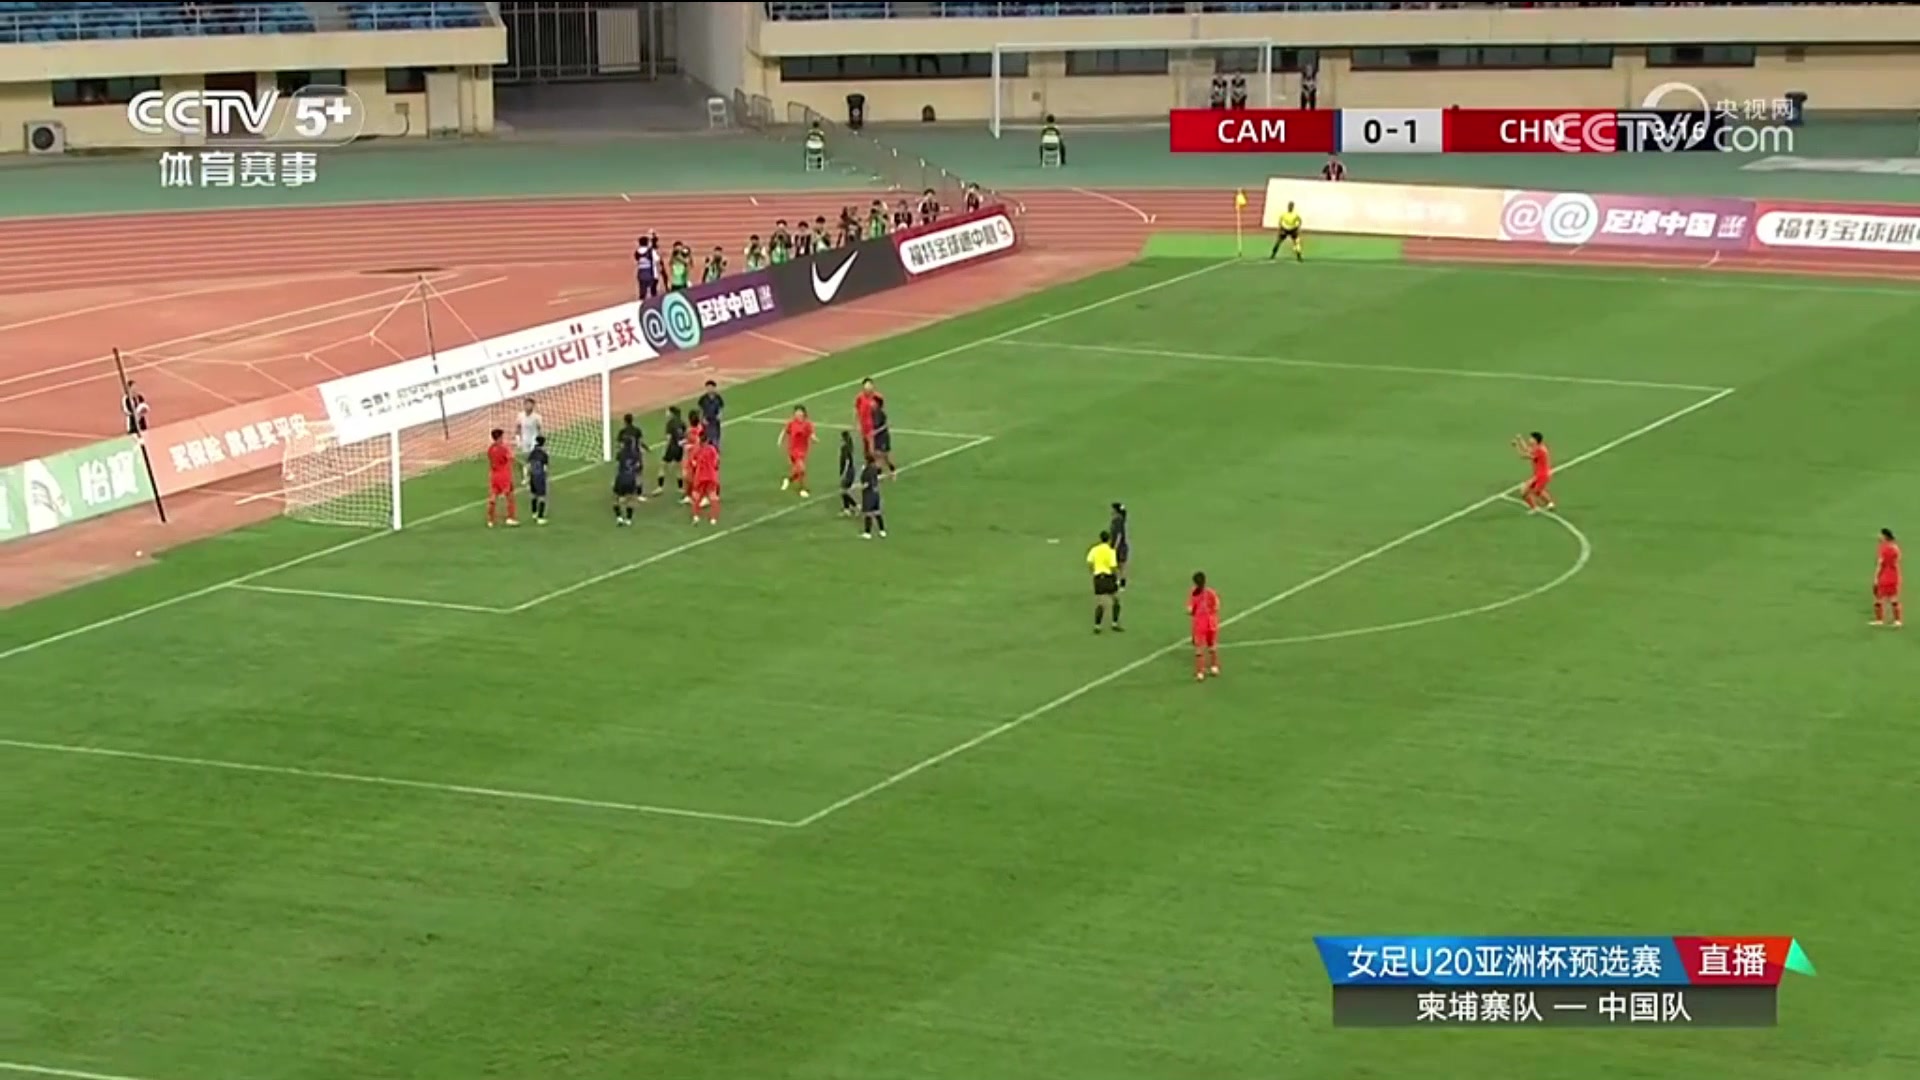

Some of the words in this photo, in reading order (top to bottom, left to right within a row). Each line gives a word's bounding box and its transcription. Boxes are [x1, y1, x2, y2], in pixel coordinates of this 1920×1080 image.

[1602, 208, 1717, 238] 足球中国
[1774, 216, 1920, 246] 福特宝球迷
[696, 287, 761, 329] 足球中国
[501, 323, 590, 391] yuwell
